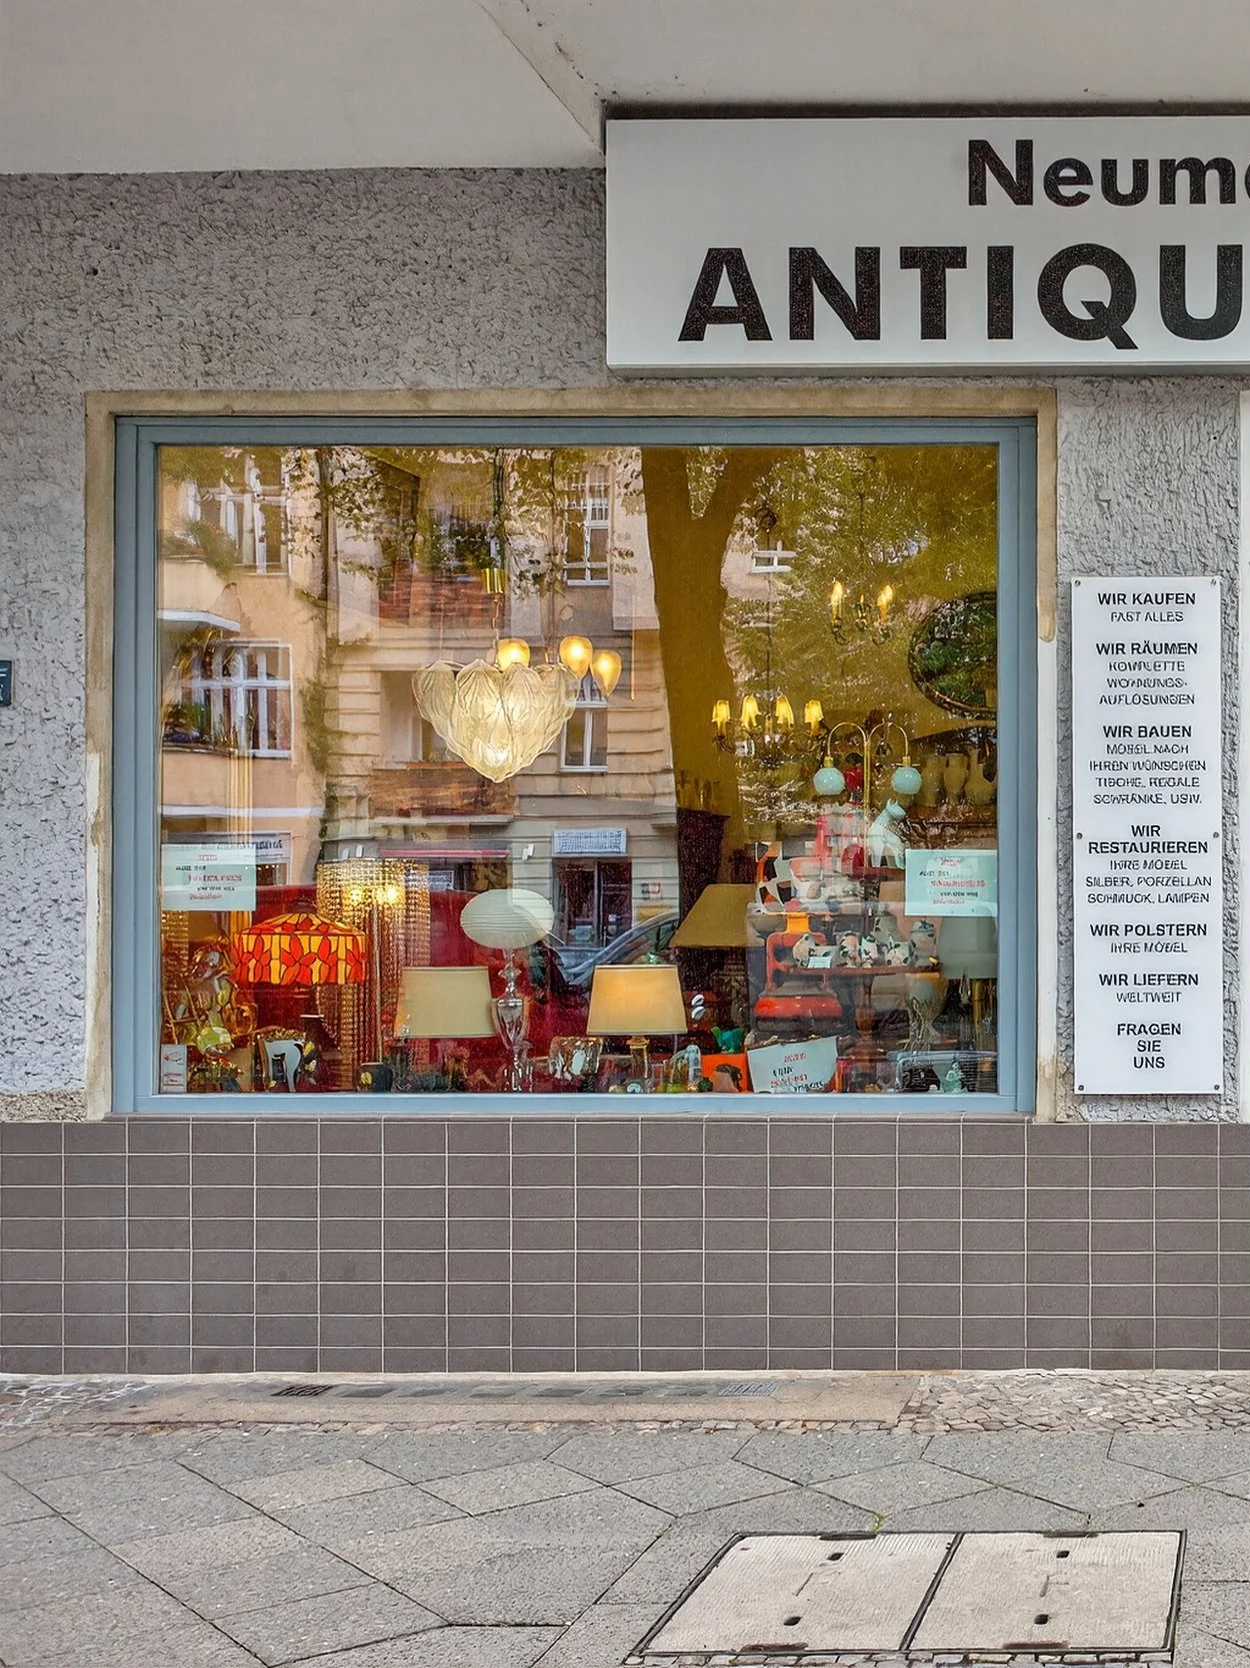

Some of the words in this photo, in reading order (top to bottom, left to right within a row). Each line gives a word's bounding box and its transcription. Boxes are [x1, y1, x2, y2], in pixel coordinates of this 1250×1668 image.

[1098, 593, 1127, 605] WIR
[1132, 593, 1195, 605] KAUFEN
[1111, 611, 1141, 622] FAST
[1145, 611, 1184, 622] ALLES
[1096, 643, 1126, 655] WIR
[1131, 640, 1197, 655] RÄUMEN
[1103, 725, 1133, 738] WIR
[1138, 725, 1191, 738] BAUEN
[1131, 825, 1161, 837] WIR
[1089, 840, 1208, 857] RESTAURIEREN
[1090, 924, 1120, 936] WIR
[1124, 923, 1207, 936] POLSTERN
[1099, 973, 1128, 986] WIR
[1134, 973, 1198, 986] LIEFERN
[1117, 992, 1182, 1003] WELTWEIT
[1117, 1023, 1181, 1038] FRAGEN
[1137, 1040, 1161, 1052] SIE
[1134, 1056, 1165, 1069] UNS
